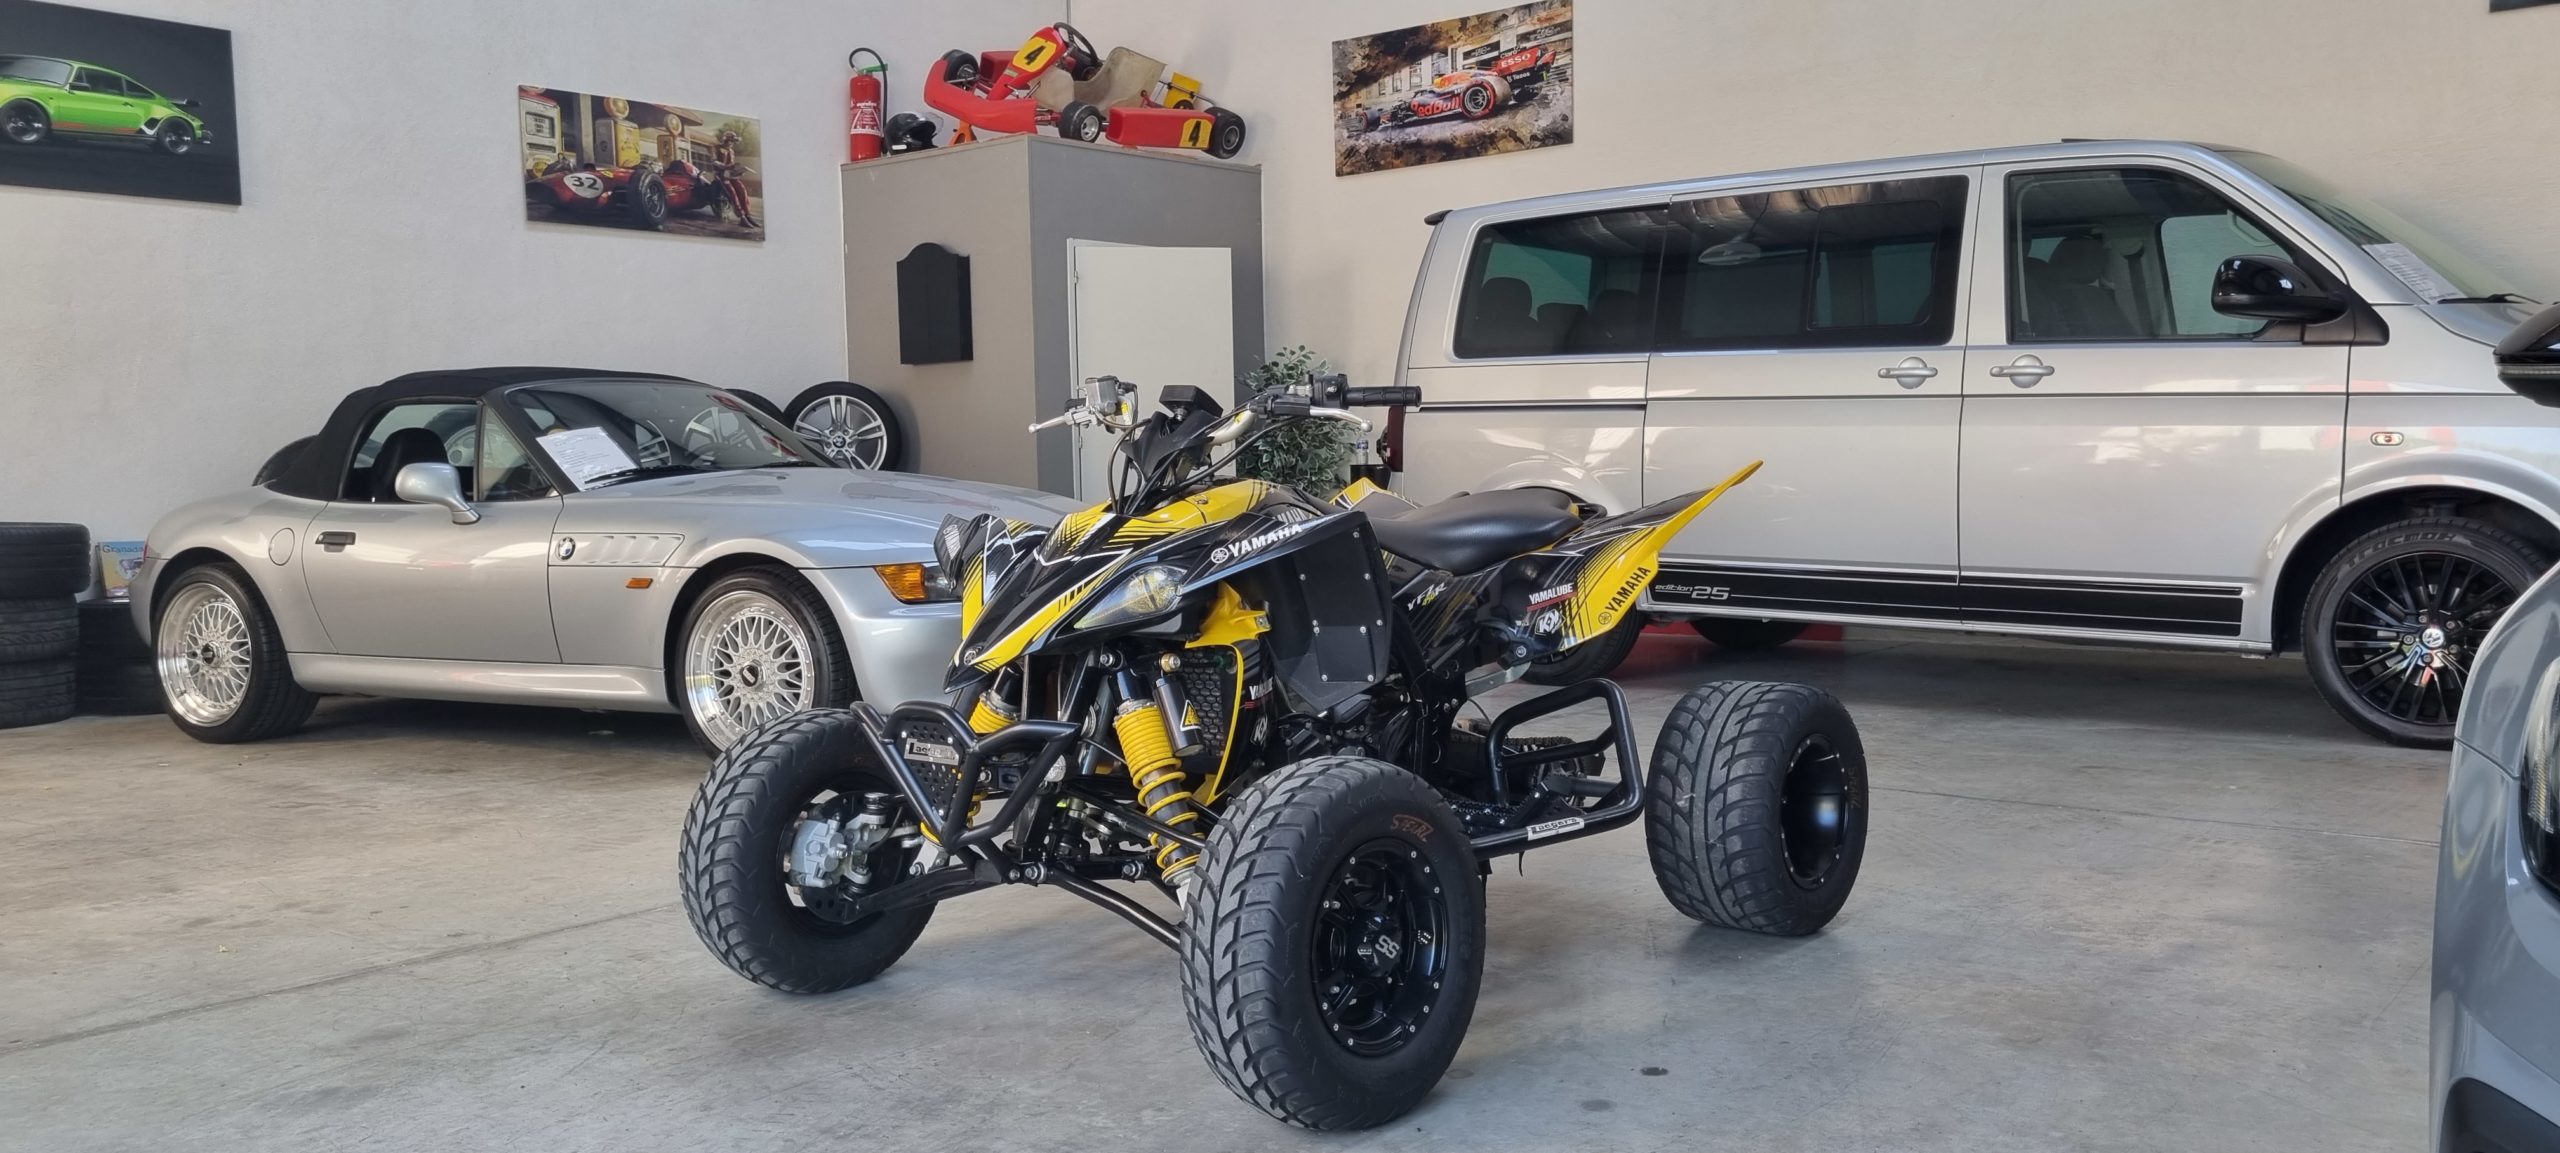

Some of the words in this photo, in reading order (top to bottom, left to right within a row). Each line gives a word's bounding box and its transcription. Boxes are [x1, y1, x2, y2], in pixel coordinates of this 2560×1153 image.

[1023, 44, 1047, 66] 4
[1501, 53, 1530, 68] ESSO
[1188, 120, 1202, 147] 4
[570, 176, 600, 191] 32
[1228, 523, 1303, 557] YAMAHA
[1529, 582, 1575, 605] YAMALUBE
[1605, 566, 1651, 613] YAMAHA
[1655, 584, 1693, 592] edition
[1691, 586, 1730, 600] 25
[1375, 934, 1400, 959] SS
